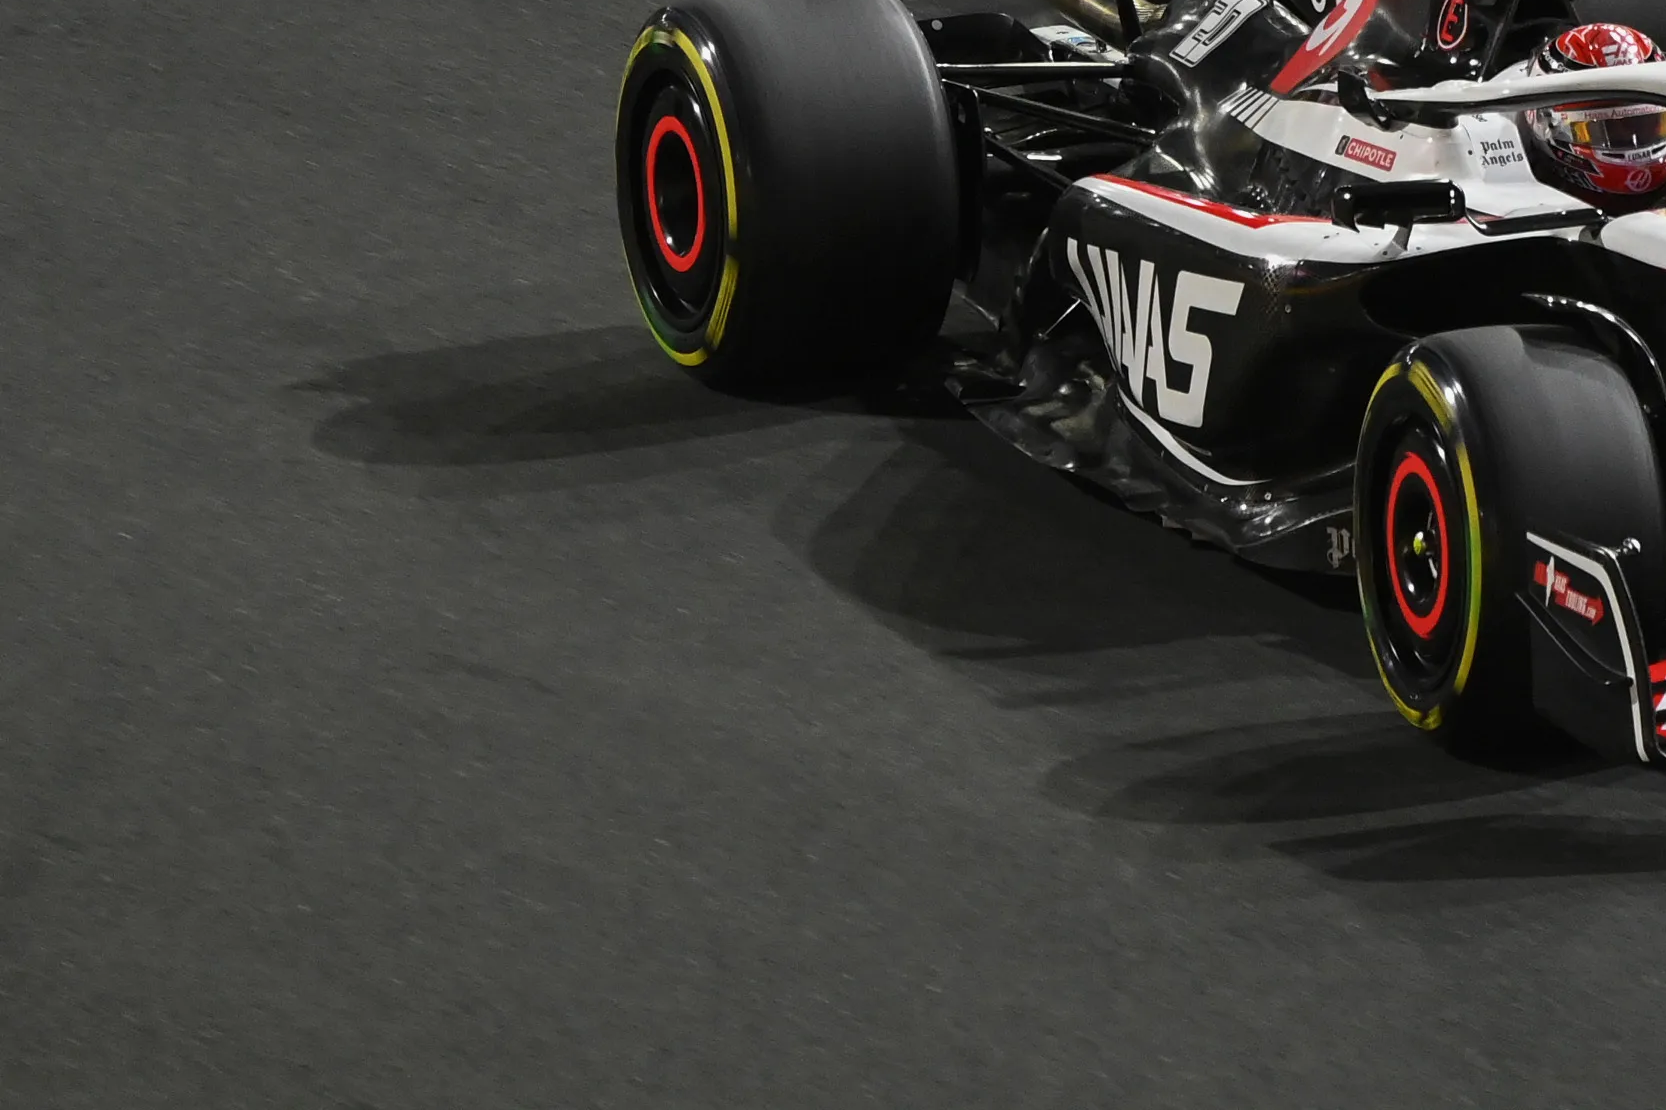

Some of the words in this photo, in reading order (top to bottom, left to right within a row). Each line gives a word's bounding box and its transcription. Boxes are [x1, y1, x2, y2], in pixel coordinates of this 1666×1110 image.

[1347, 142, 1394, 167] CHIPOTLE
[1480, 138, 1514, 154] Palm
[1481, 151, 1524, 168] Angels
[1067, 237, 1245, 428] HAAS
